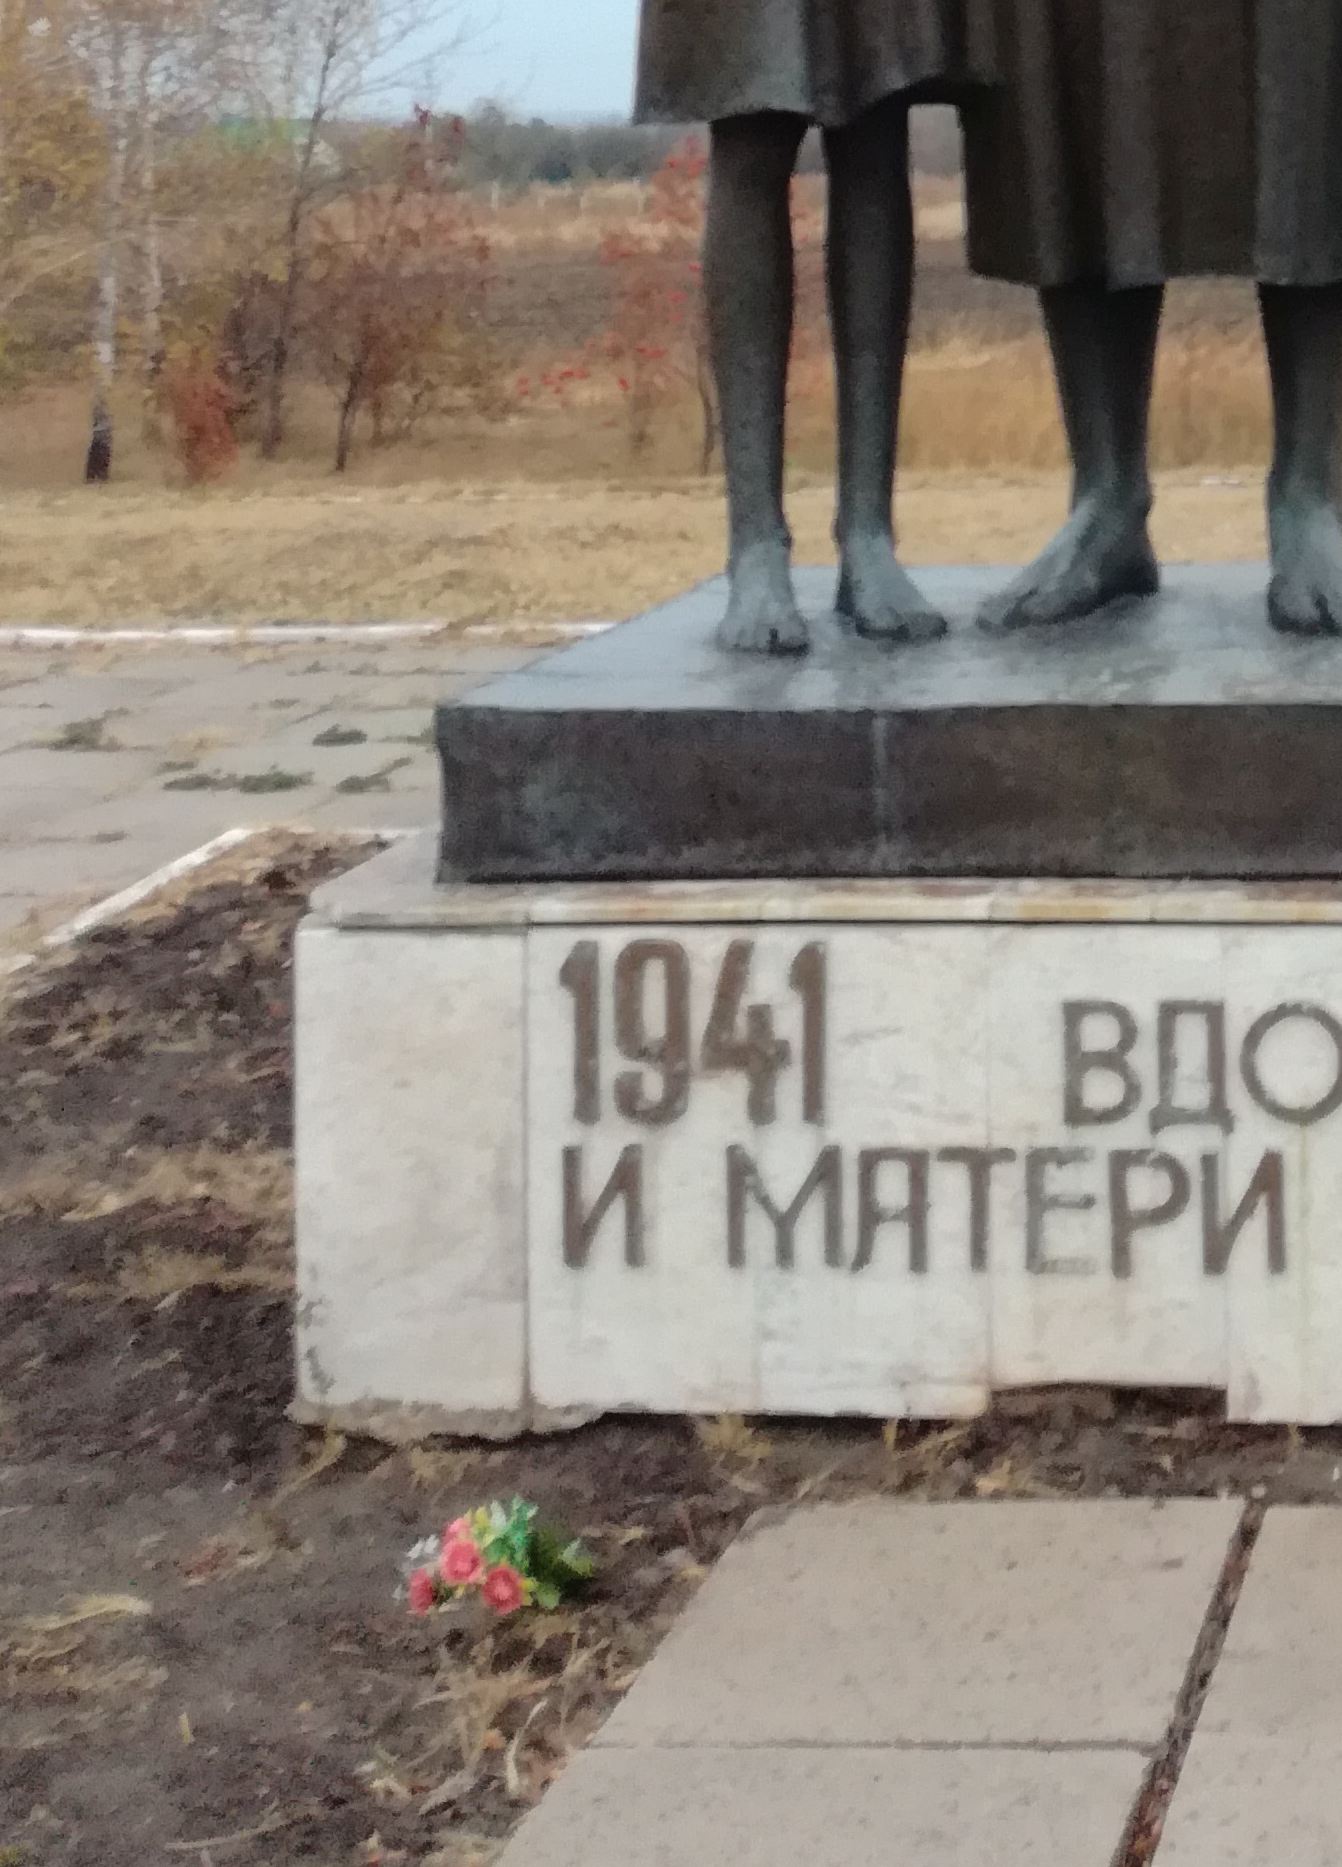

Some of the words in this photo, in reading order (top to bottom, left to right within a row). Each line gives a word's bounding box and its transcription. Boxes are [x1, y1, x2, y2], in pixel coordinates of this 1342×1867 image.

[559, 939, 826, 1126] 1941
[561, 1142, 647, 1269] И
[725, 1142, 1286, 1279] МАТЕРИ
